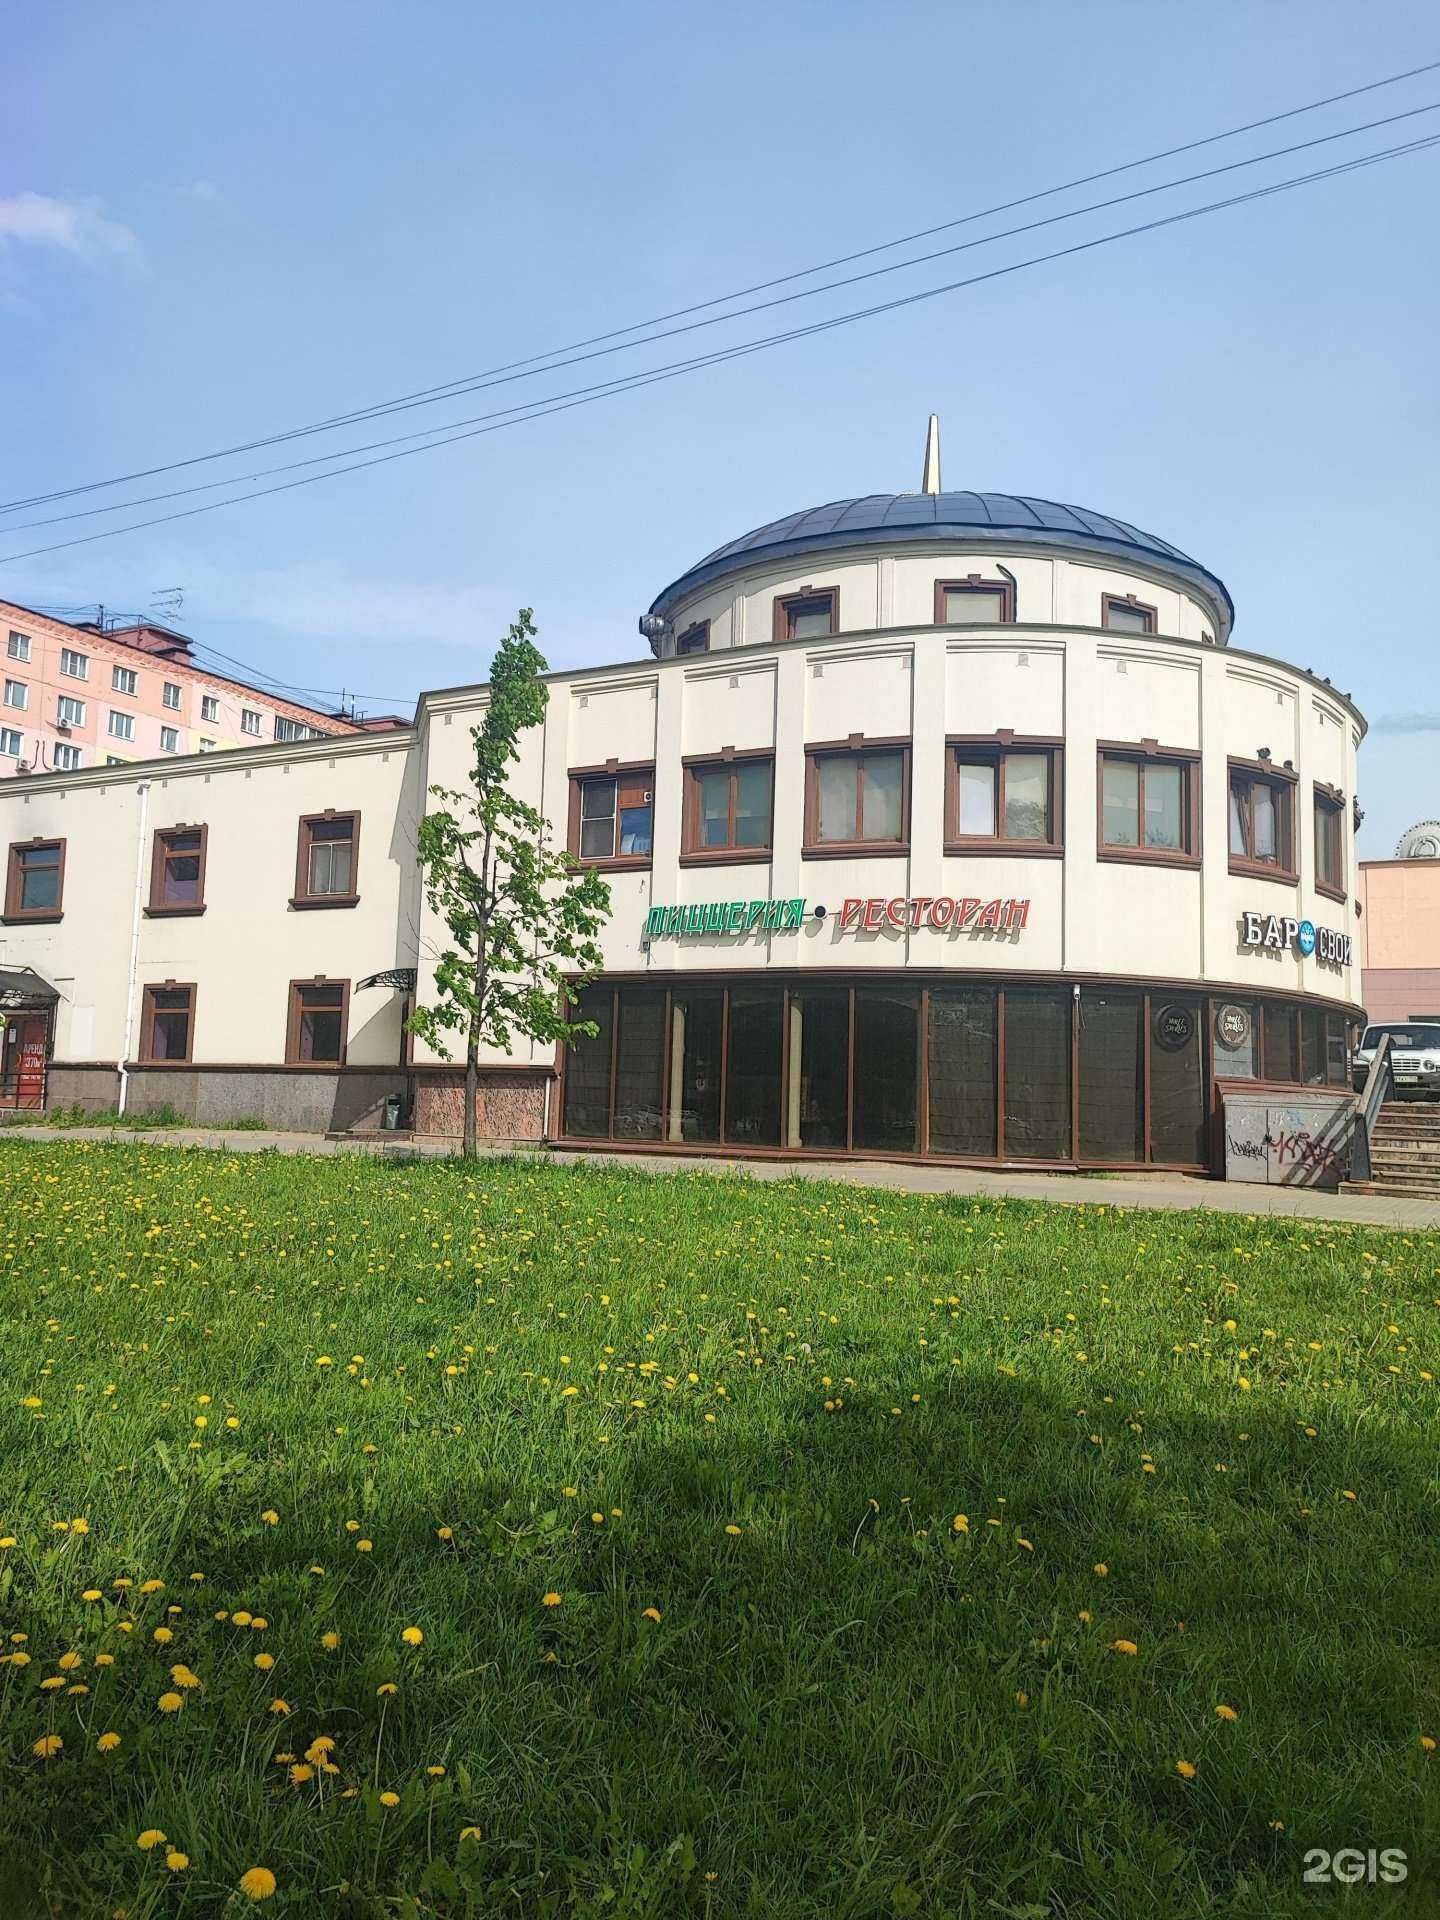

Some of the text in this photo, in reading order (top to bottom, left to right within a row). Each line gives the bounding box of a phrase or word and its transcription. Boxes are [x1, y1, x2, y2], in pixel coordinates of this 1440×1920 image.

[647, 897, 1032, 934] ПИЦЦЕРИЯ РЕСТОРАН
[1242, 911, 1299, 950] БАР
